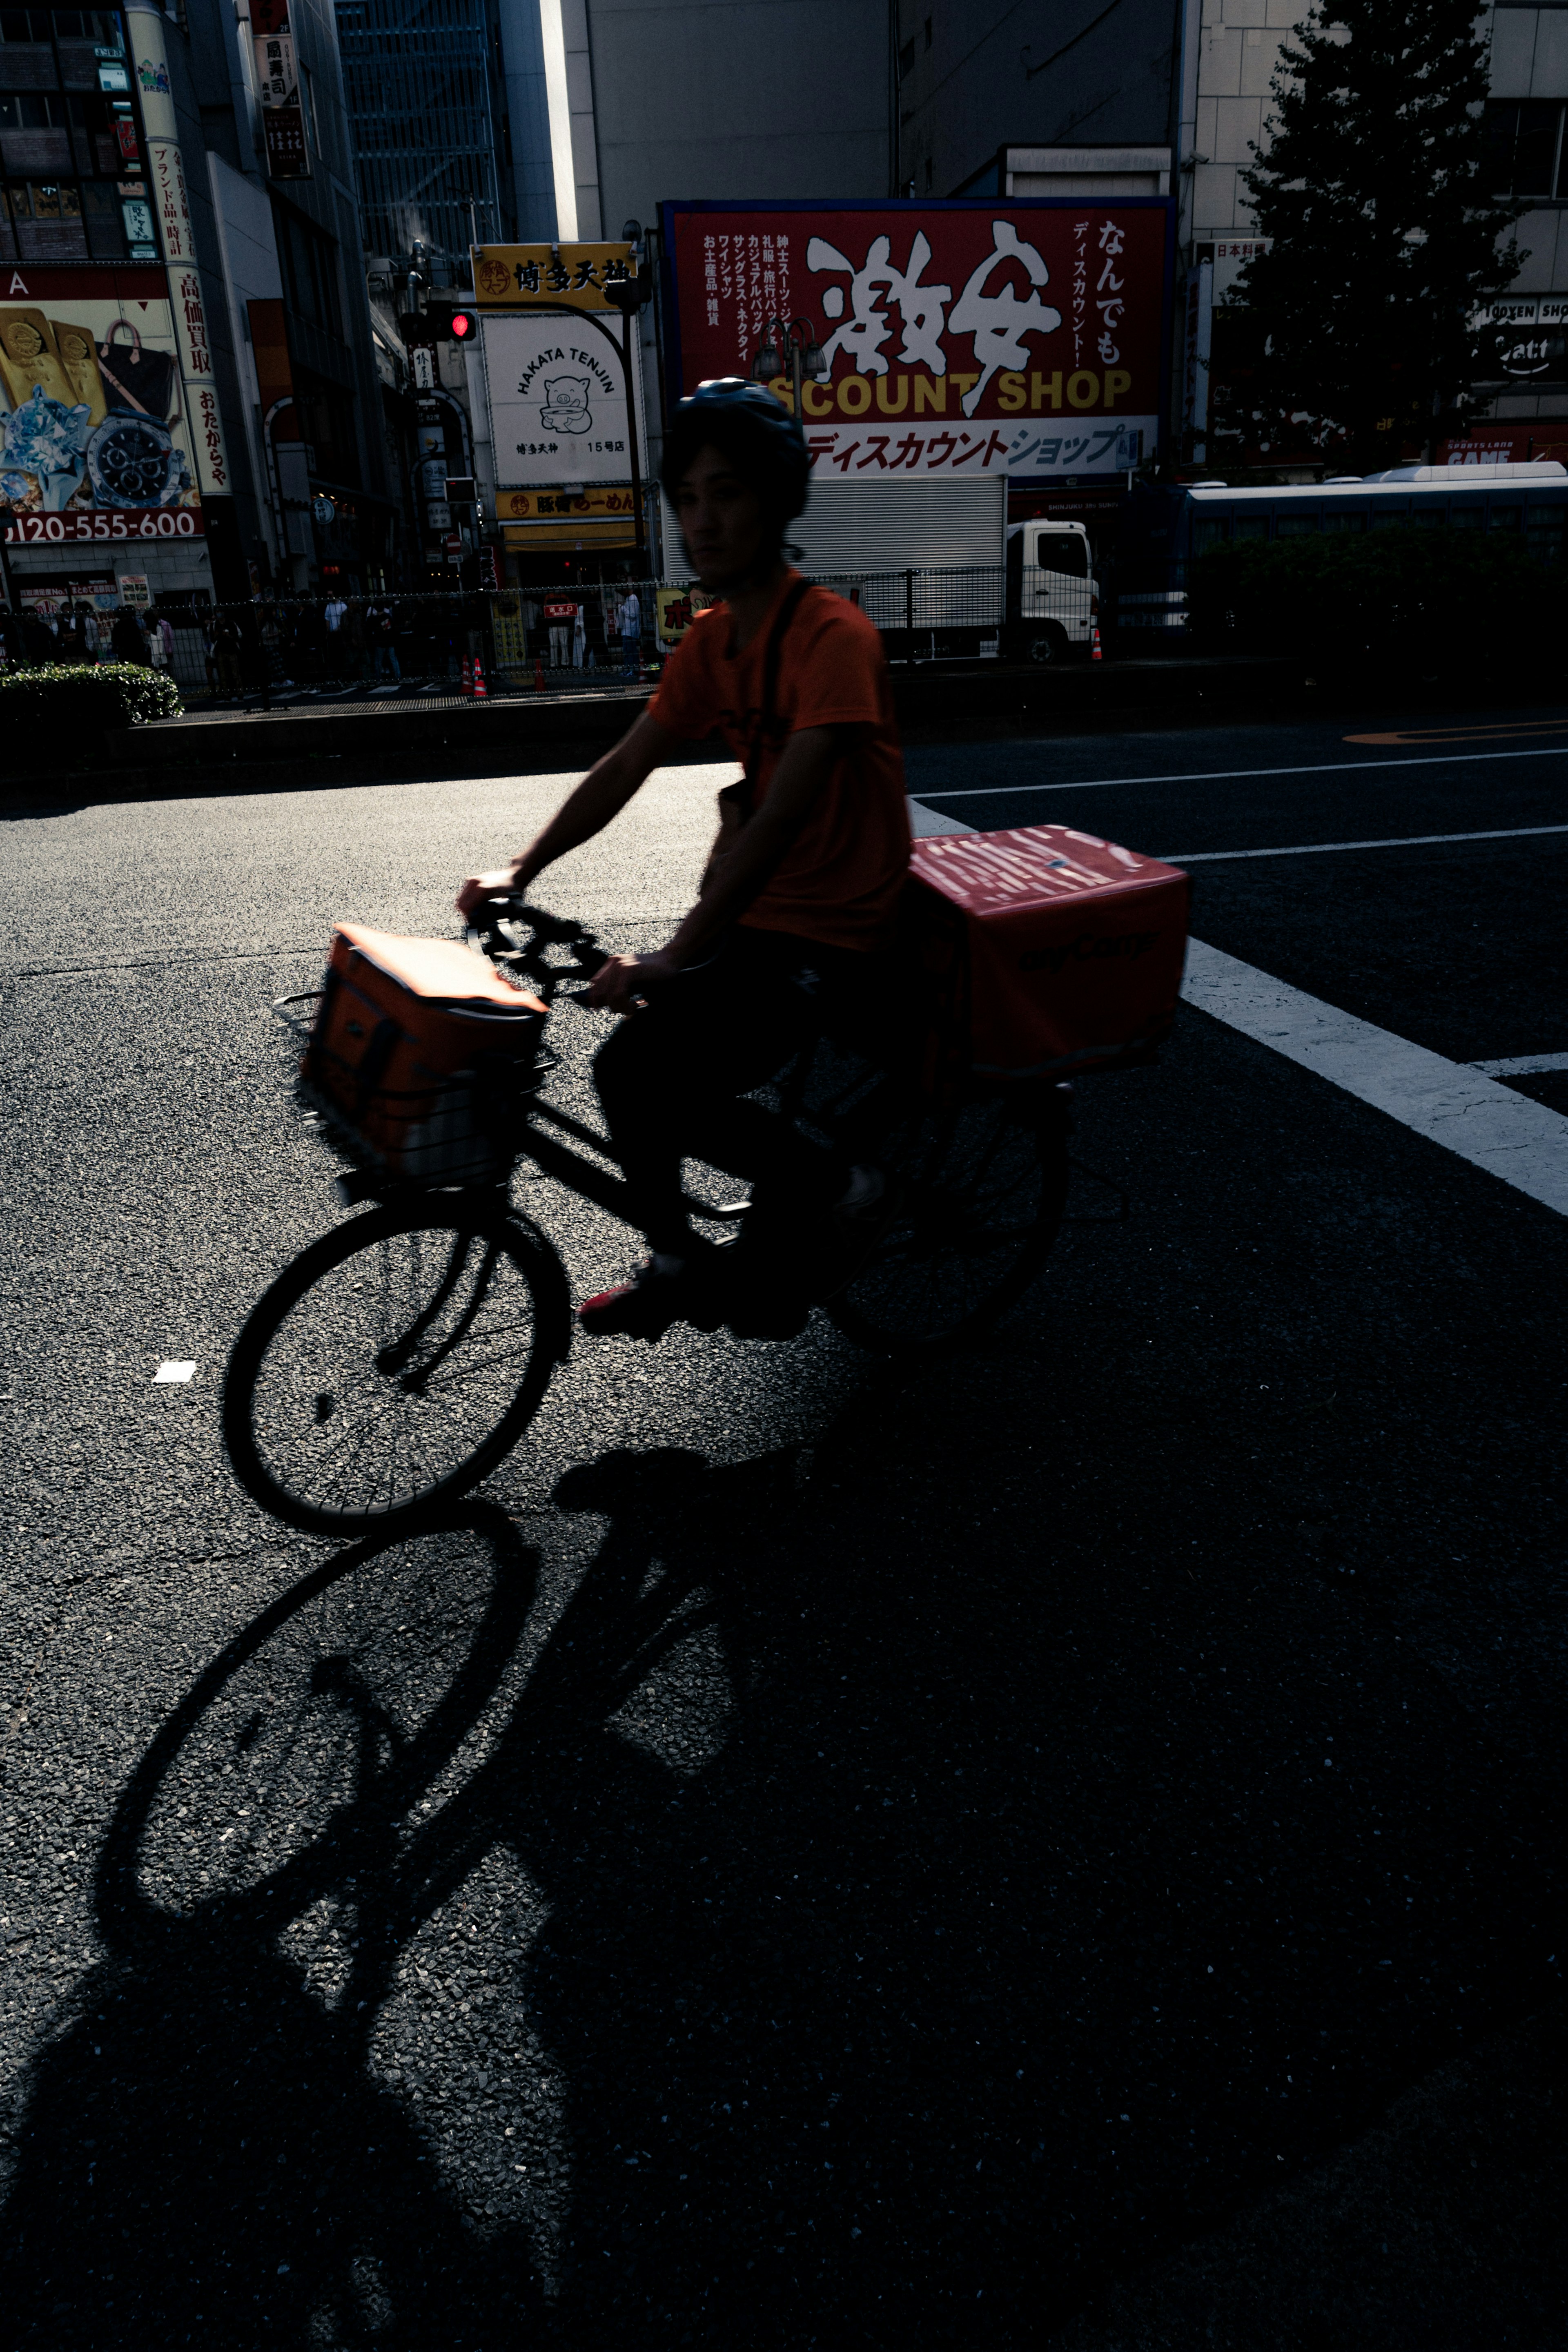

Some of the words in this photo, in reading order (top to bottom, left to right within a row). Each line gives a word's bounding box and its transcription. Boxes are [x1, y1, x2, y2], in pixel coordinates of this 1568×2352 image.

[267, 41, 285, 94] 扇寿司
[155, 149, 182, 255] ブランド品・時計
[9, 270, 29, 294] A
[704, 235, 719, 326] お土産品・雑貨
[719, 235, 732, 299] ワイシャツ
[748, 234, 763, 334] カジュアルバッグ
[1096, 221, 1125, 365] なんでも
[178, 274, 211, 373] 高価買取
[733, 235, 748, 361] サングラス・ネクタイ
[807, 219, 1062, 419] 激安
[1486, 305, 1534, 318] 100YEN
[518, 348, 564, 395] HAKATA
[570, 348, 615, 393] TENJIN
[998, 369, 1131, 411] SHOP
[200, 391, 226, 486] おたからや
[516, 443, 558, 455] 博多天神
[588, 441, 624, 452] 15号店
[1448, 450, 1510, 466] GAME
[537, 493, 634, 513] 豚骨らーめん
